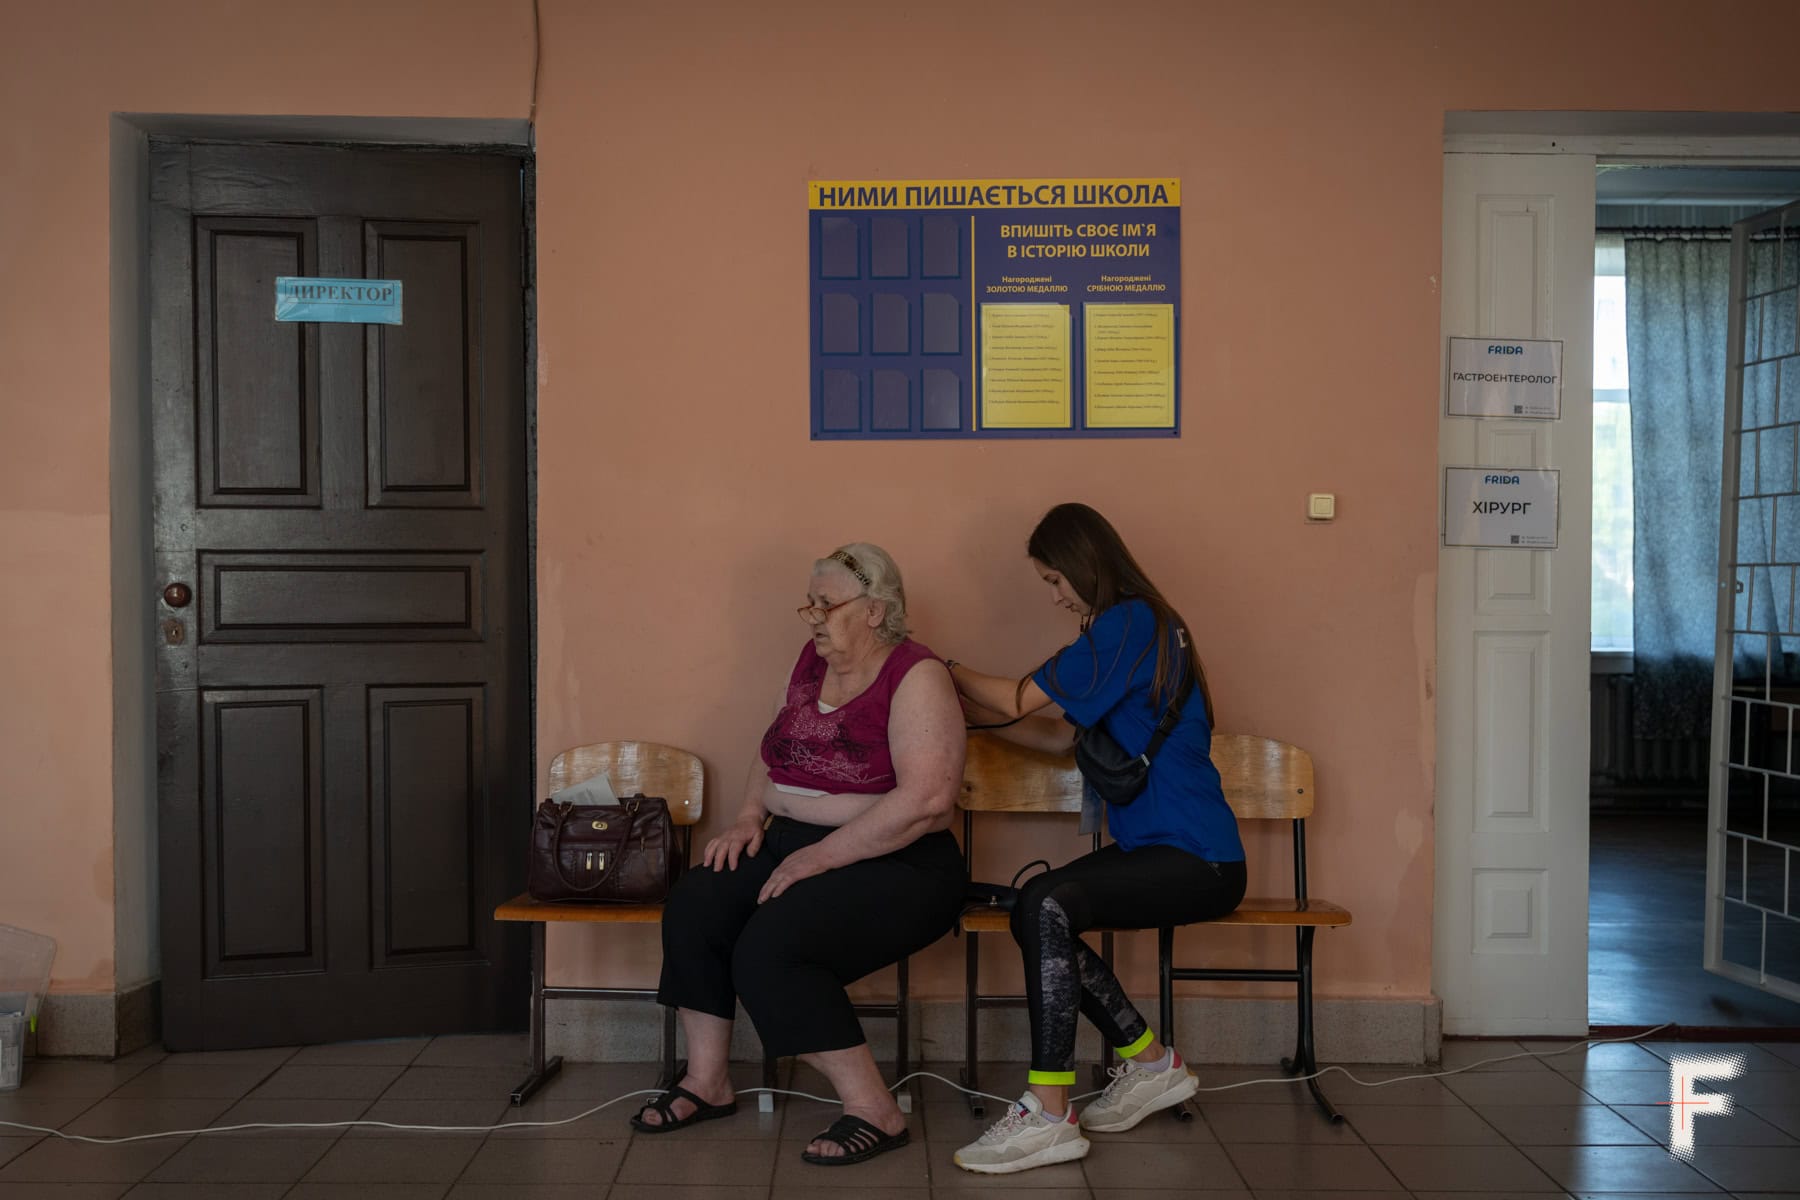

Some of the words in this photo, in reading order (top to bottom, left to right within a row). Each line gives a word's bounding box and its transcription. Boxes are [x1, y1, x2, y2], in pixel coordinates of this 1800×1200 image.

[819, 187, 898, 206] НИМИ
[905, 185, 1066, 205] ПИШАЄТЬСЯ
[1073, 184, 1169, 205] ШКОЛА
[1000, 225, 1073, 238] ВПИШІТЬ
[1076, 224, 1119, 238] СВОЄ
[1007, 245, 1017, 258] В
[1021, 245, 1087, 258] ІСТОРІЮ
[1090, 244, 1150, 257] ШКОЛИ
[1002, 276, 1052, 284] Нагороджені
[1101, 275, 1151, 283] Нагороджені
[986, 285, 1025, 293] ЗОЛОТОЮ
[1027, 285, 1068, 293] МЕДАЛЛЮ
[1087, 284, 1123, 292] СРІБНОЮ
[1125, 284, 1166, 292] МЕДАЛЛЮ
[1488, 345, 1523, 355] FRIDA
[1453, 372, 1557, 384] ГАСТРОЕНТЕРОЛОГ
[1484, 475, 1520, 485] FRIDA
[1472, 501, 1532, 515] ХІРУРГ
